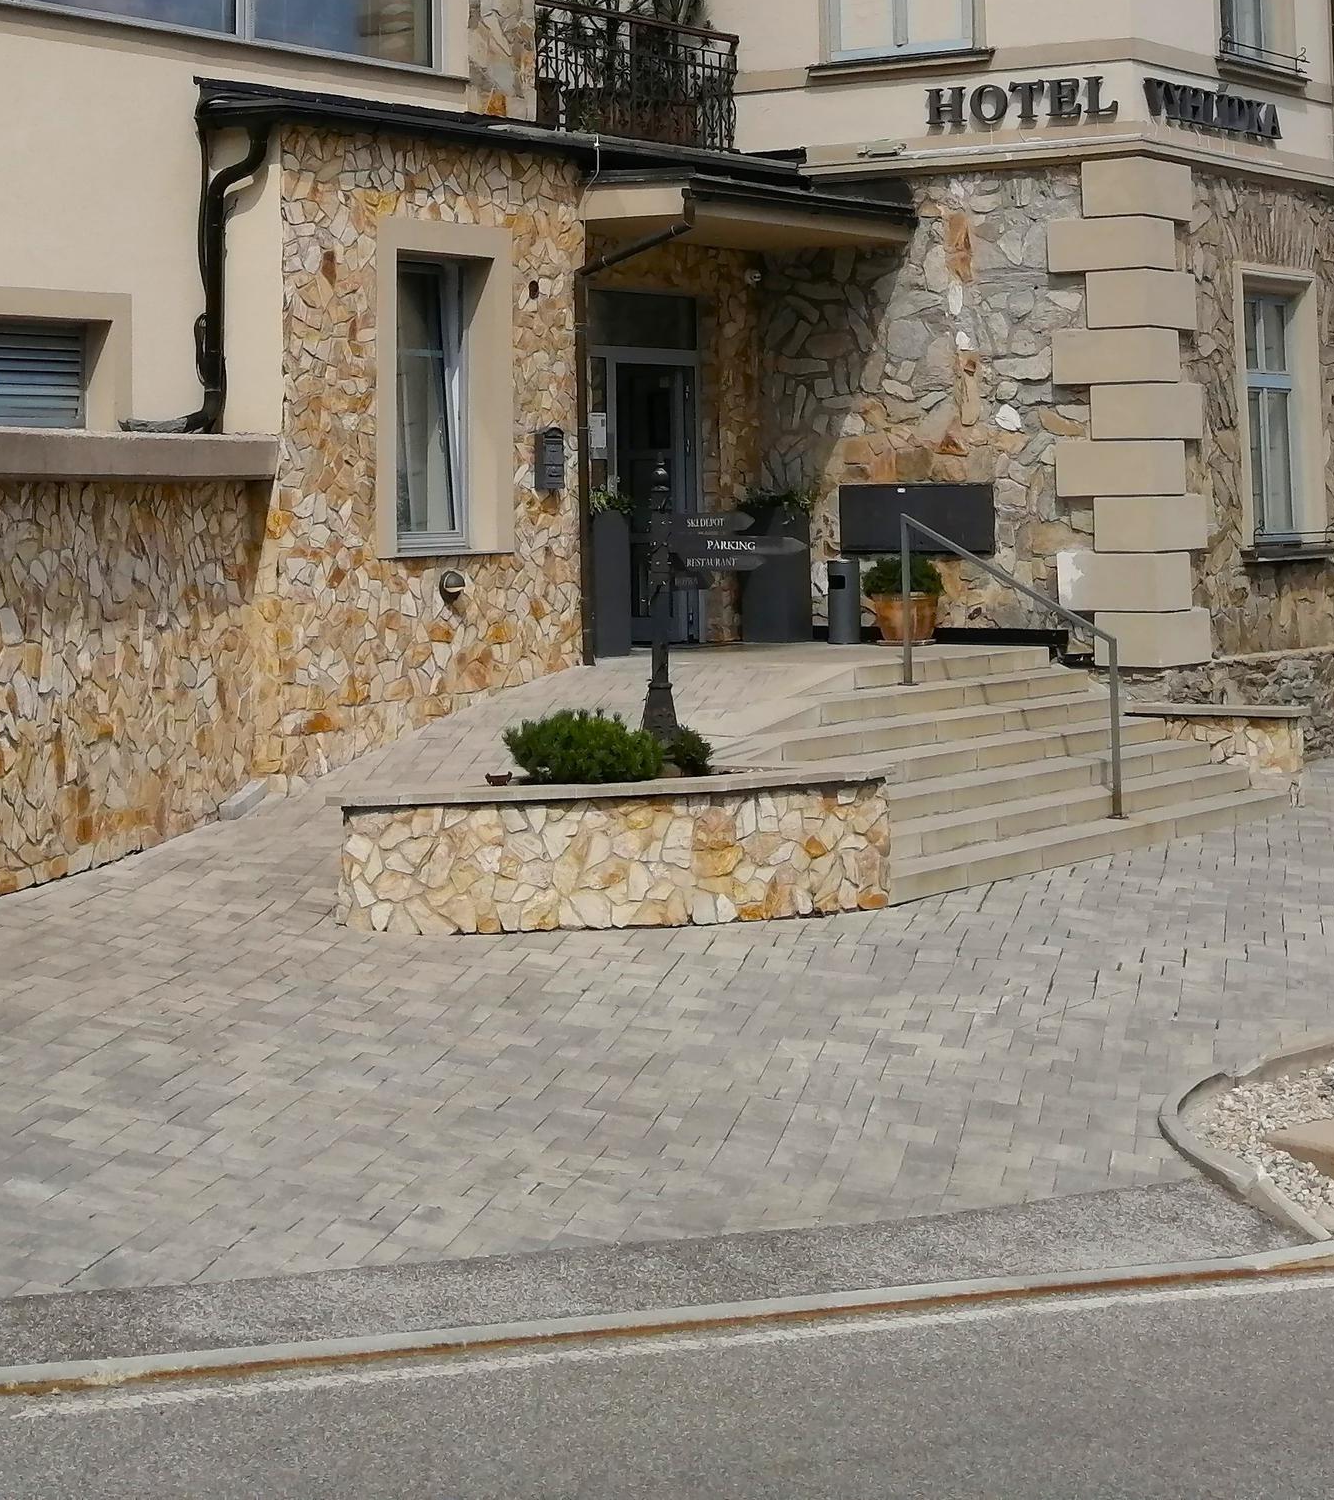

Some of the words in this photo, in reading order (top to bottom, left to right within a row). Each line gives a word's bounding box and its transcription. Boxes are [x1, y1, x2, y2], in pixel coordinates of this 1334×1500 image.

[925, 76, 1118, 125] HOTEL
[706, 540, 756, 551] PARKING
[686, 557, 738, 568] RESTAURANT
